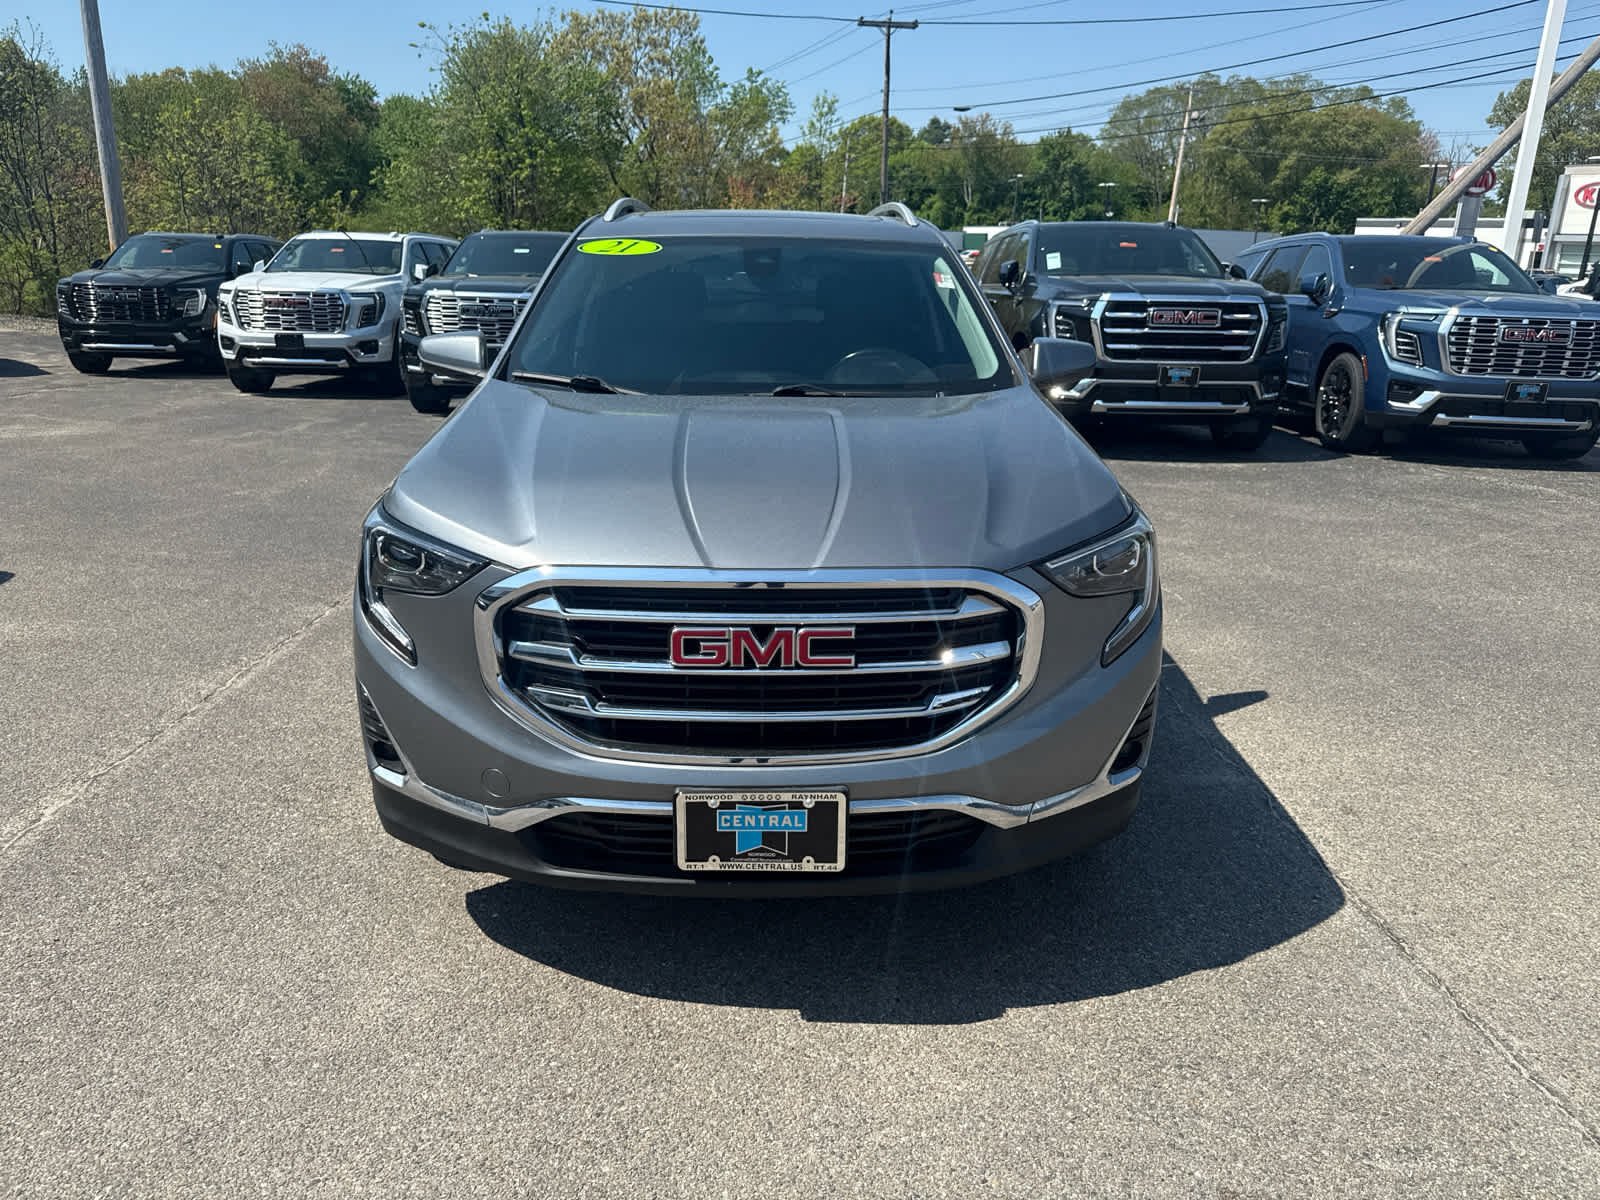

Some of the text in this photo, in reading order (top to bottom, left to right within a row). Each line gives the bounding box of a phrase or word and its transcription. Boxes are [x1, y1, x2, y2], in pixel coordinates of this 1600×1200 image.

[596, 240, 639, 252] 21
[1153, 310, 1218, 324] GMC
[1504, 328, 1571, 342] GMC
[670, 626, 856, 668] GMC
[720, 815, 803, 827] CENTRAL
[718, 863, 803, 871] WWW.CENTRAL.US
